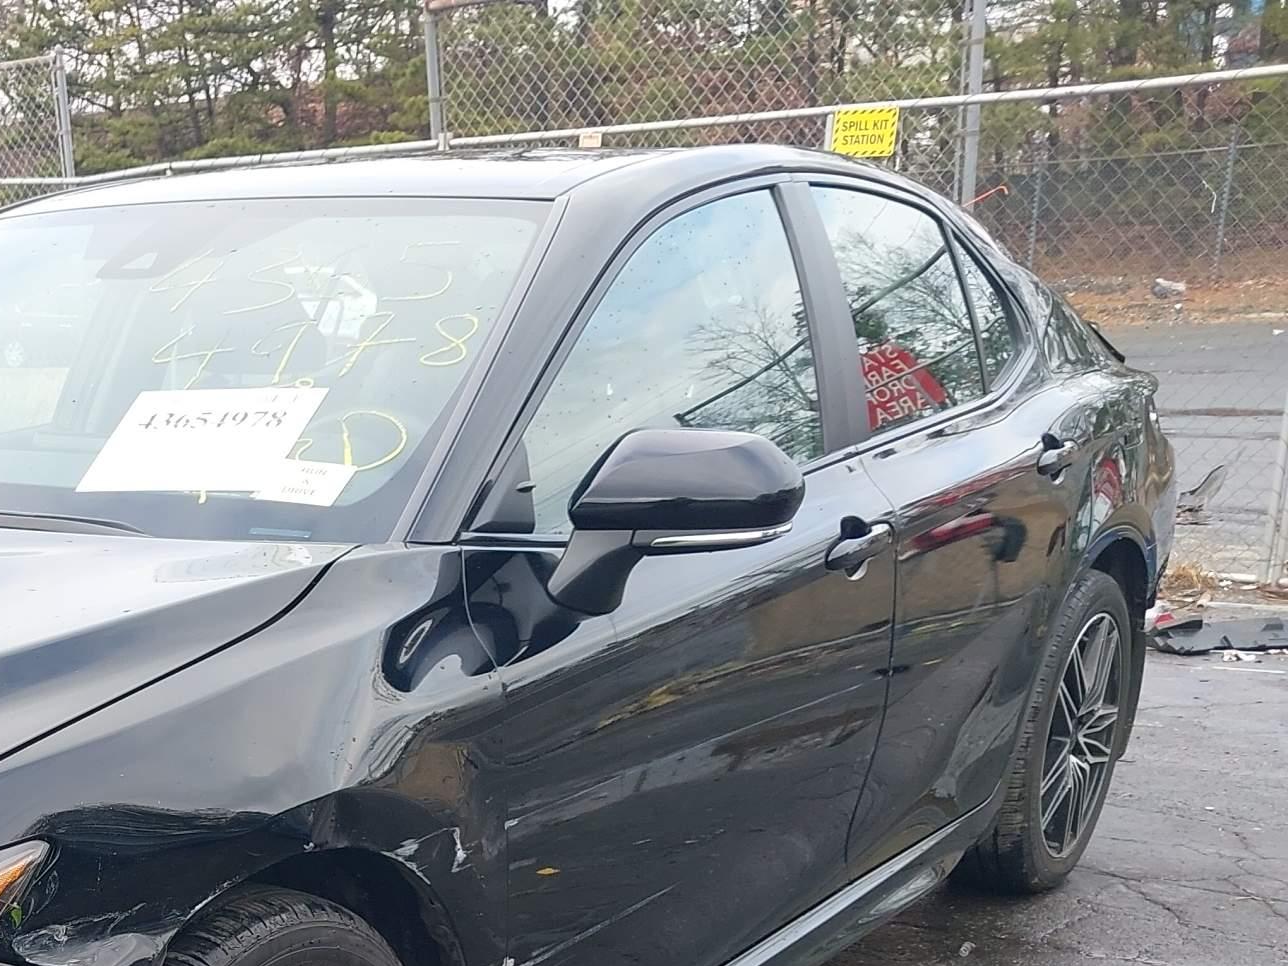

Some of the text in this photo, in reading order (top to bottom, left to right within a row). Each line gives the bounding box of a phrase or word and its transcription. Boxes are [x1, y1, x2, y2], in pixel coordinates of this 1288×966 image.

[841, 119, 889, 132] SPILL KIT
[841, 134, 884, 146] STATION
[138, 411, 288, 430] 43654978
